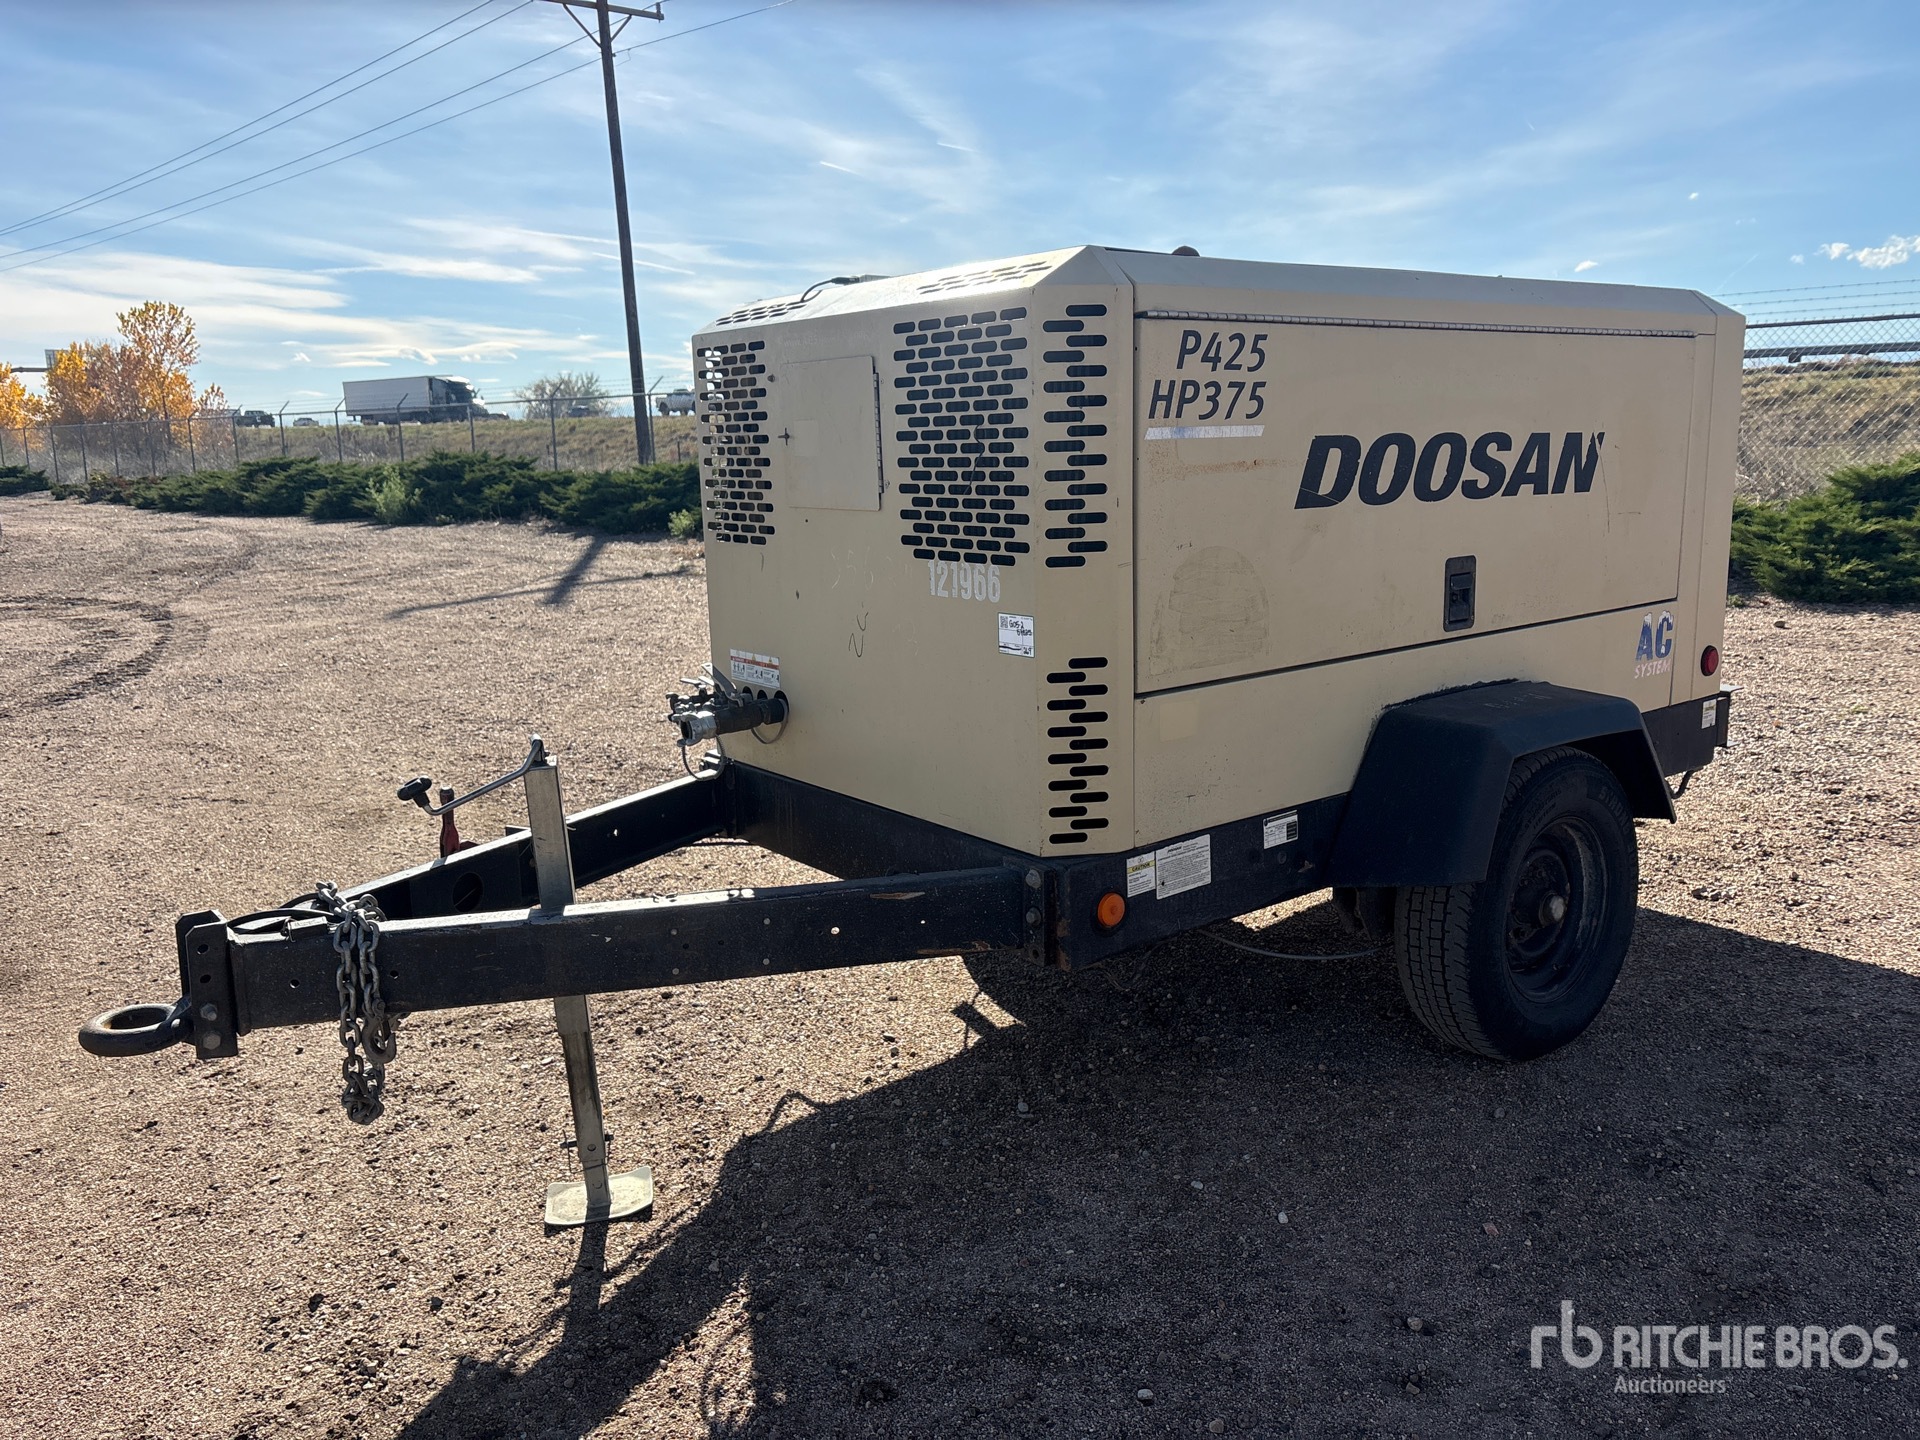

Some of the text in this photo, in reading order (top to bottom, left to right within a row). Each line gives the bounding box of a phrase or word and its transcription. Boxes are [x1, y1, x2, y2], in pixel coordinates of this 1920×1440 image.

[1176, 330, 1268, 372] P425
[1148, 380, 1267, 420] HP375
[1294, 431, 1605, 509] DOOSAN
[928, 560, 1000, 603] 121966
[1635, 610, 1674, 661] AC
[1634, 659, 1671, 679] SYSTEM
